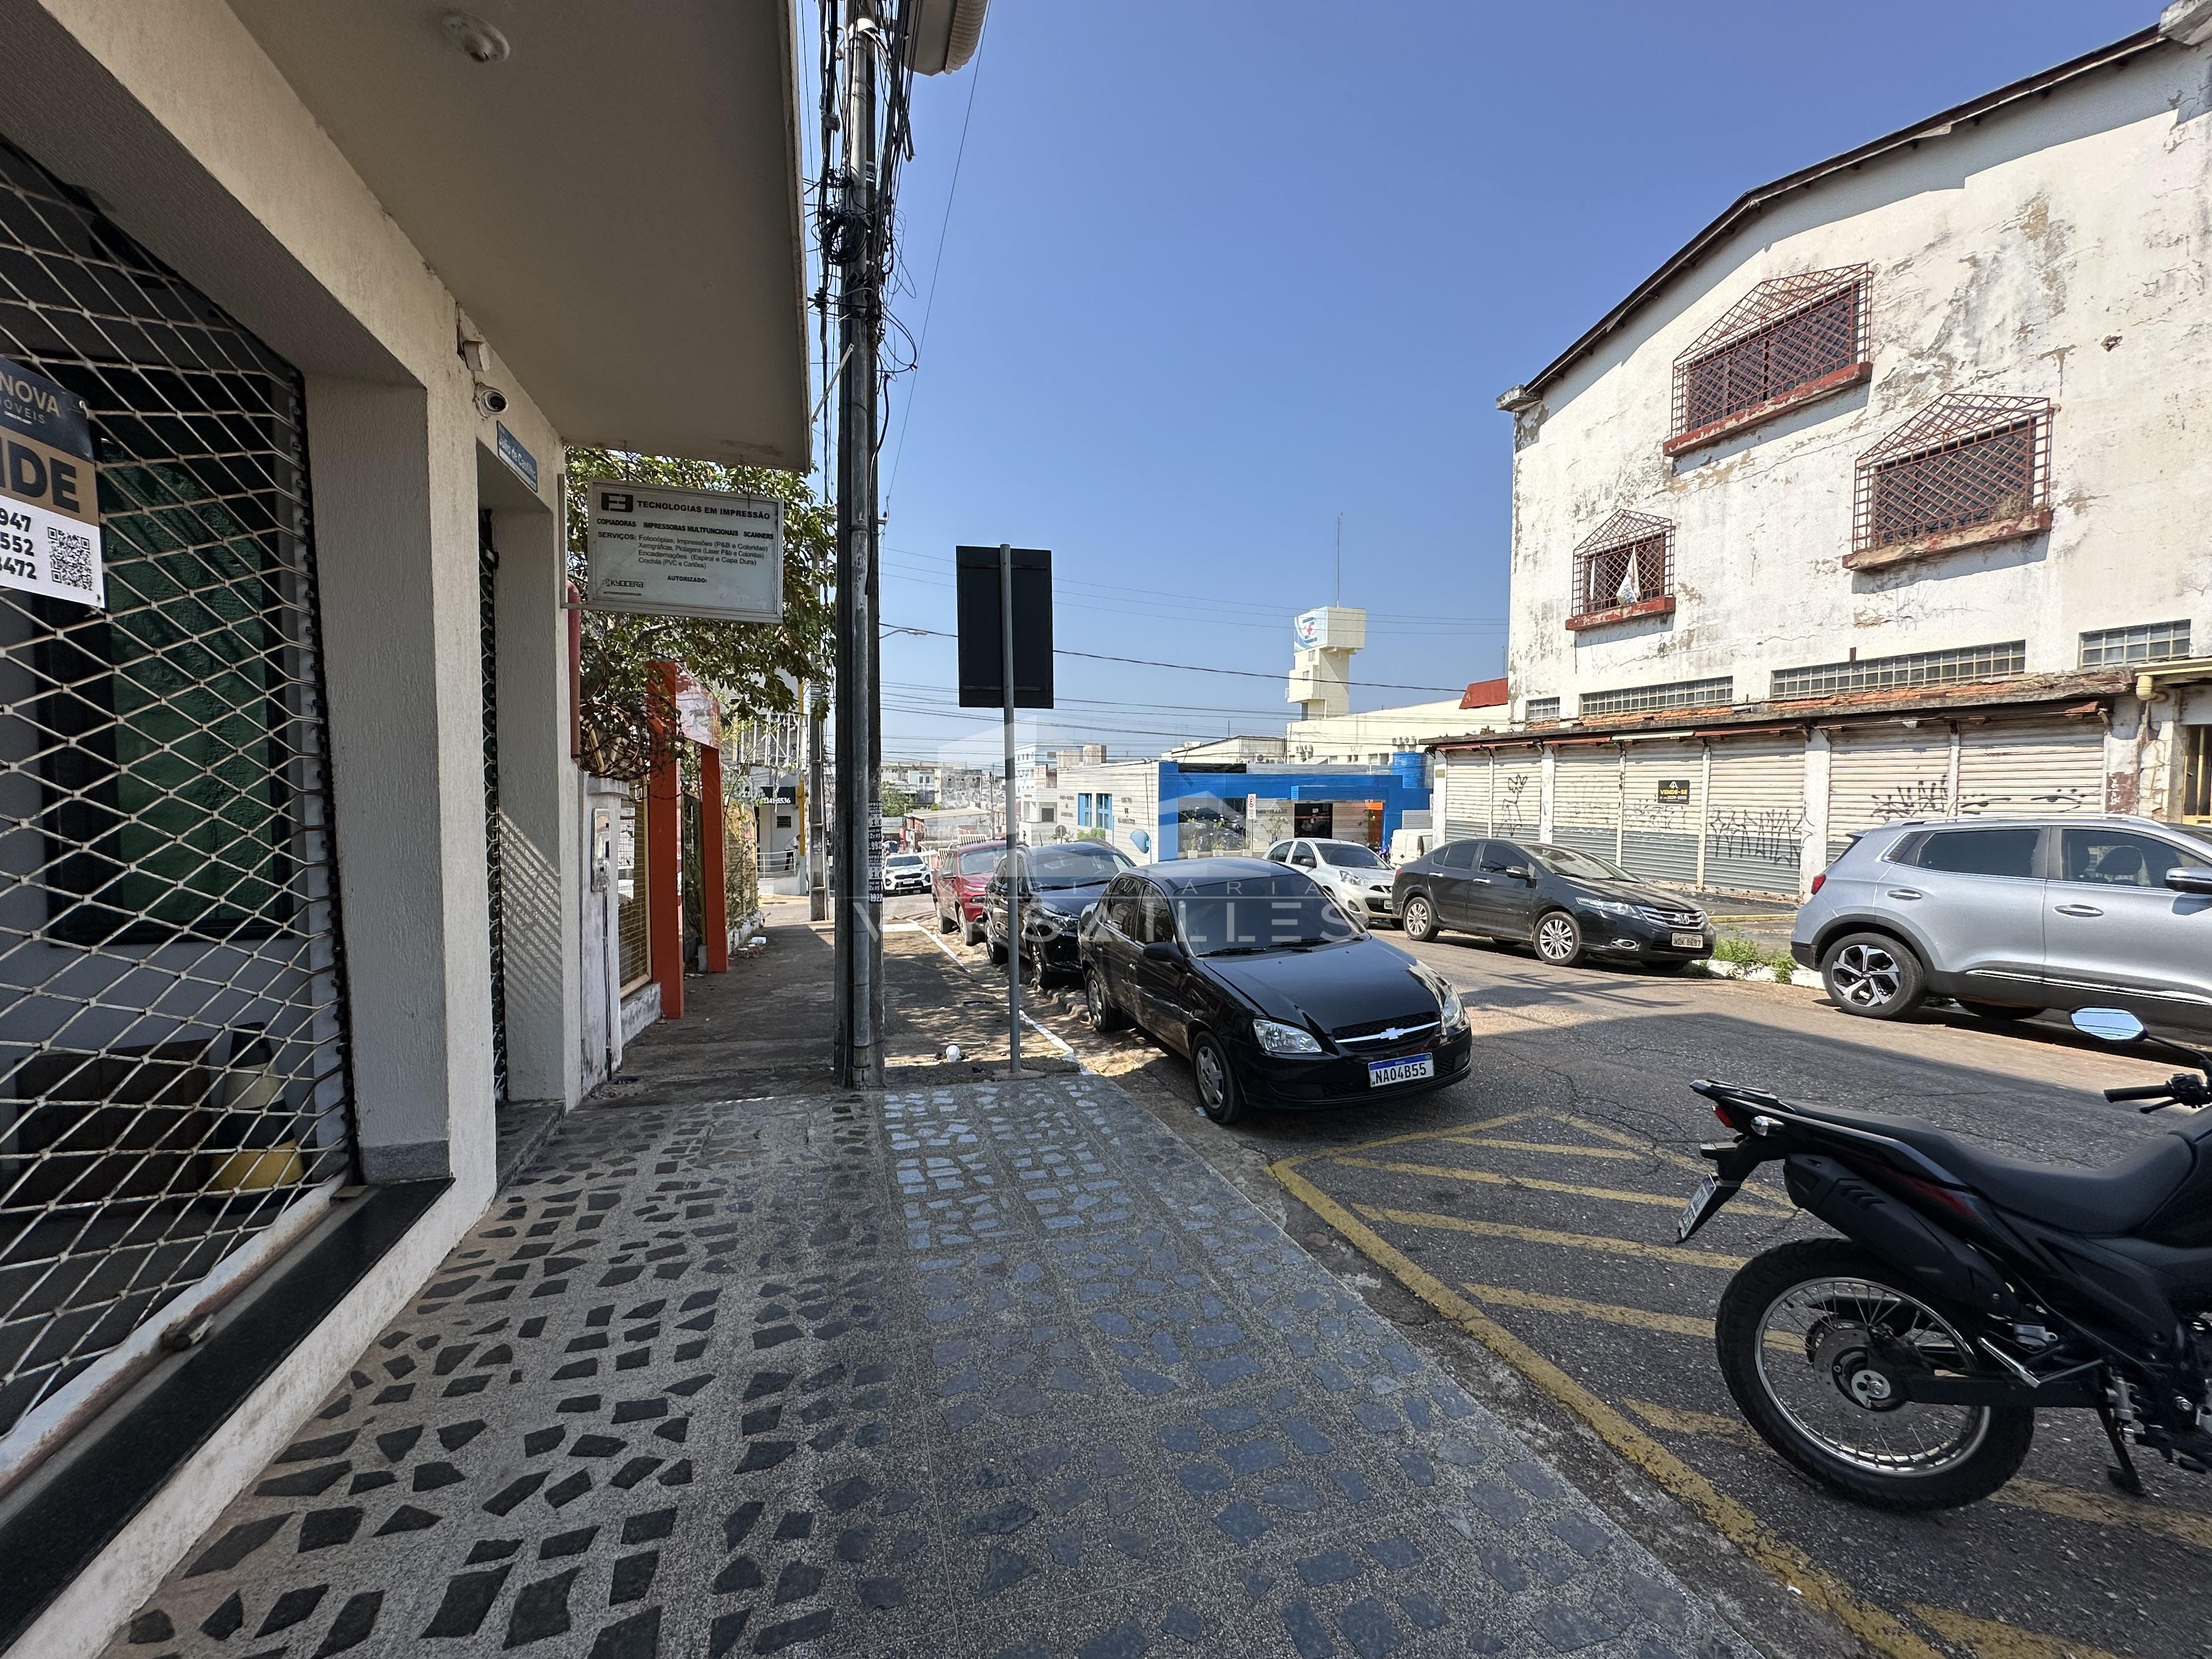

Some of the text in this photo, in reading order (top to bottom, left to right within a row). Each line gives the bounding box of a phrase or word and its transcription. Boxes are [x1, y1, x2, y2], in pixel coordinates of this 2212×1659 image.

[0, 397, 45, 424] ÓVEIS
[0, 437, 80, 514] DE
[637, 500, 702, 512] TECNOLOGIAS
[720, 508, 770, 520] IMPRESSÃO
[597, 518, 636, 527] COPIADORAS
[644, 522, 686, 531] IMPRESSORAS
[743, 531, 774, 539] SCANNERS
[597, 531, 637, 540] SERVIÇOS:
[676, 538, 713, 548] Impressões
[738, 543, 768, 553] Coloridas)
[639, 550, 687, 560] Encadernações
